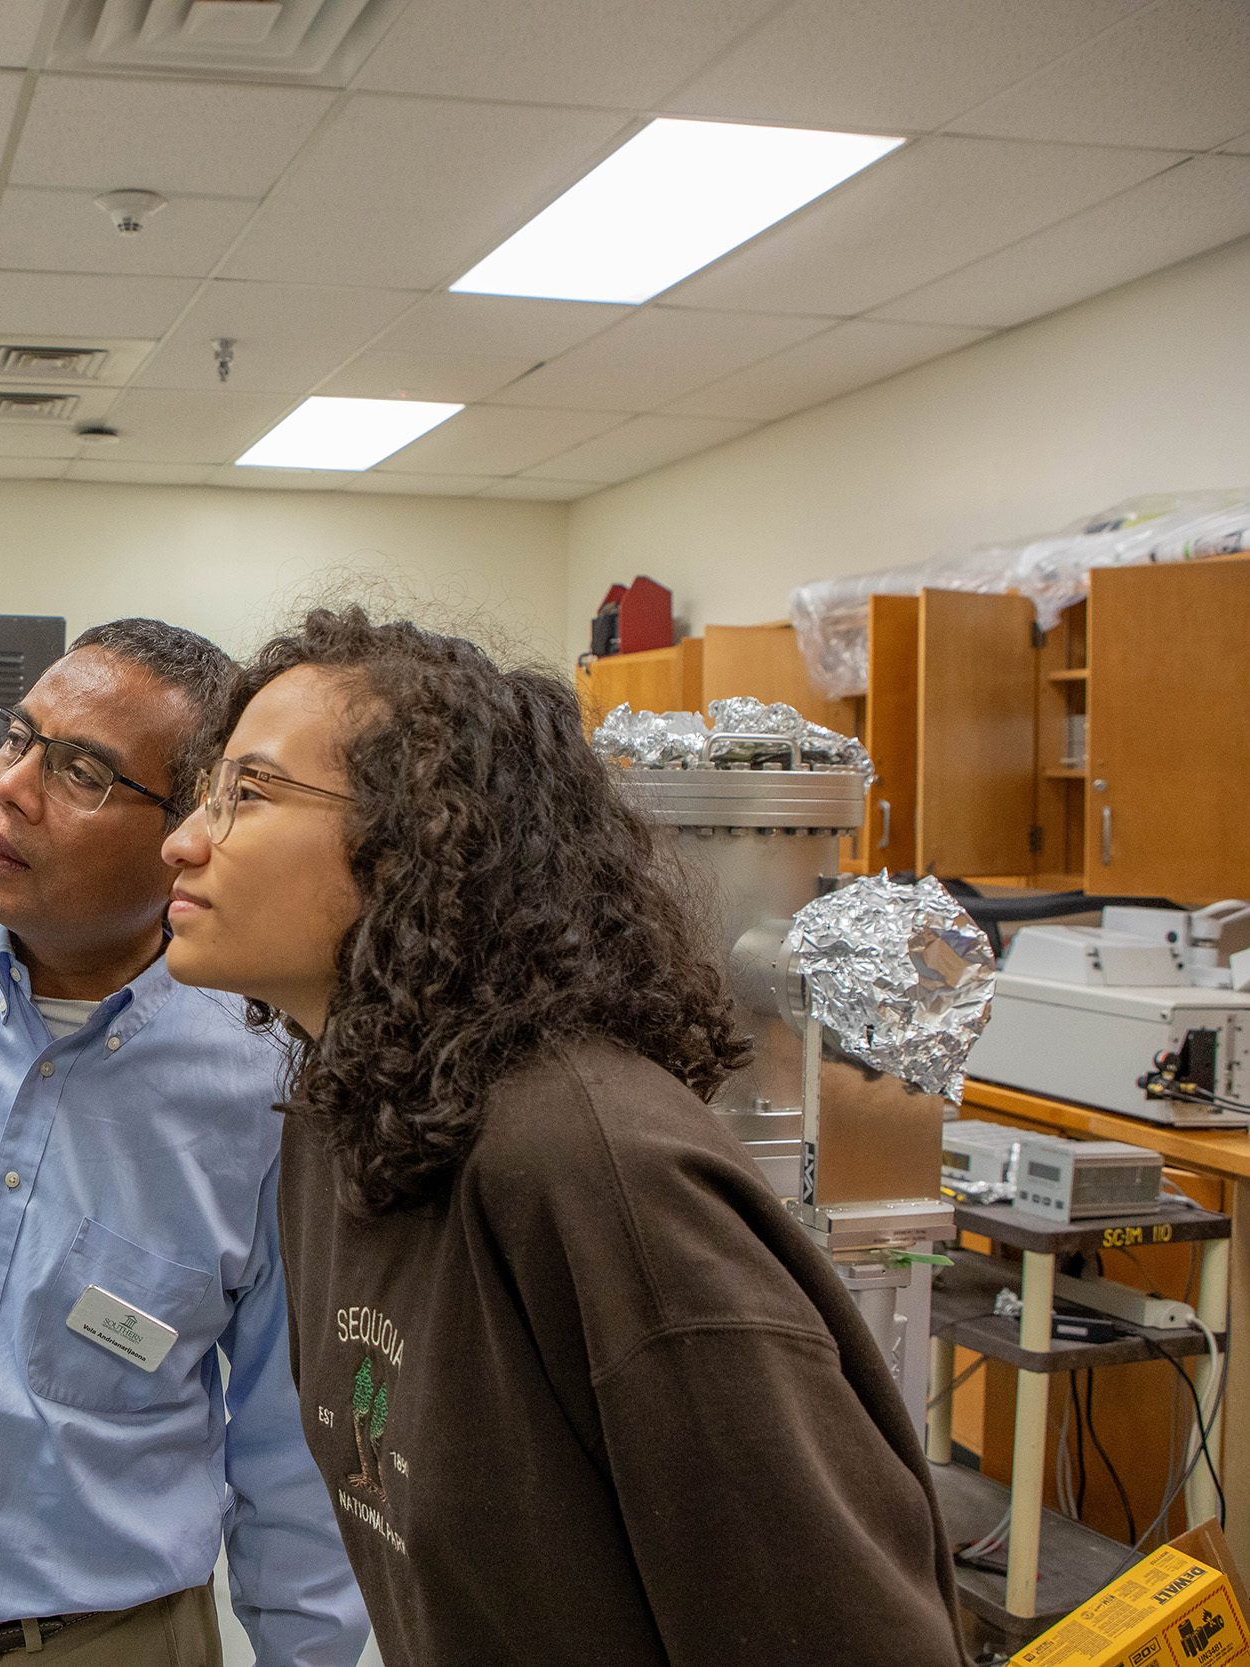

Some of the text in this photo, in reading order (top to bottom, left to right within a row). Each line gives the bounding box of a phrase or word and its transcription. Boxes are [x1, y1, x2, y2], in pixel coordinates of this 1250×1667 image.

[103, 1317, 144, 1343] SOUTHERN
[337, 1306, 404, 1376] SEQUOIA
[318, 1405, 334, 1428] EST
[338, 1488, 386, 1537] NATIONAL
[1197, 1640, 1223, 1664] UN3481
